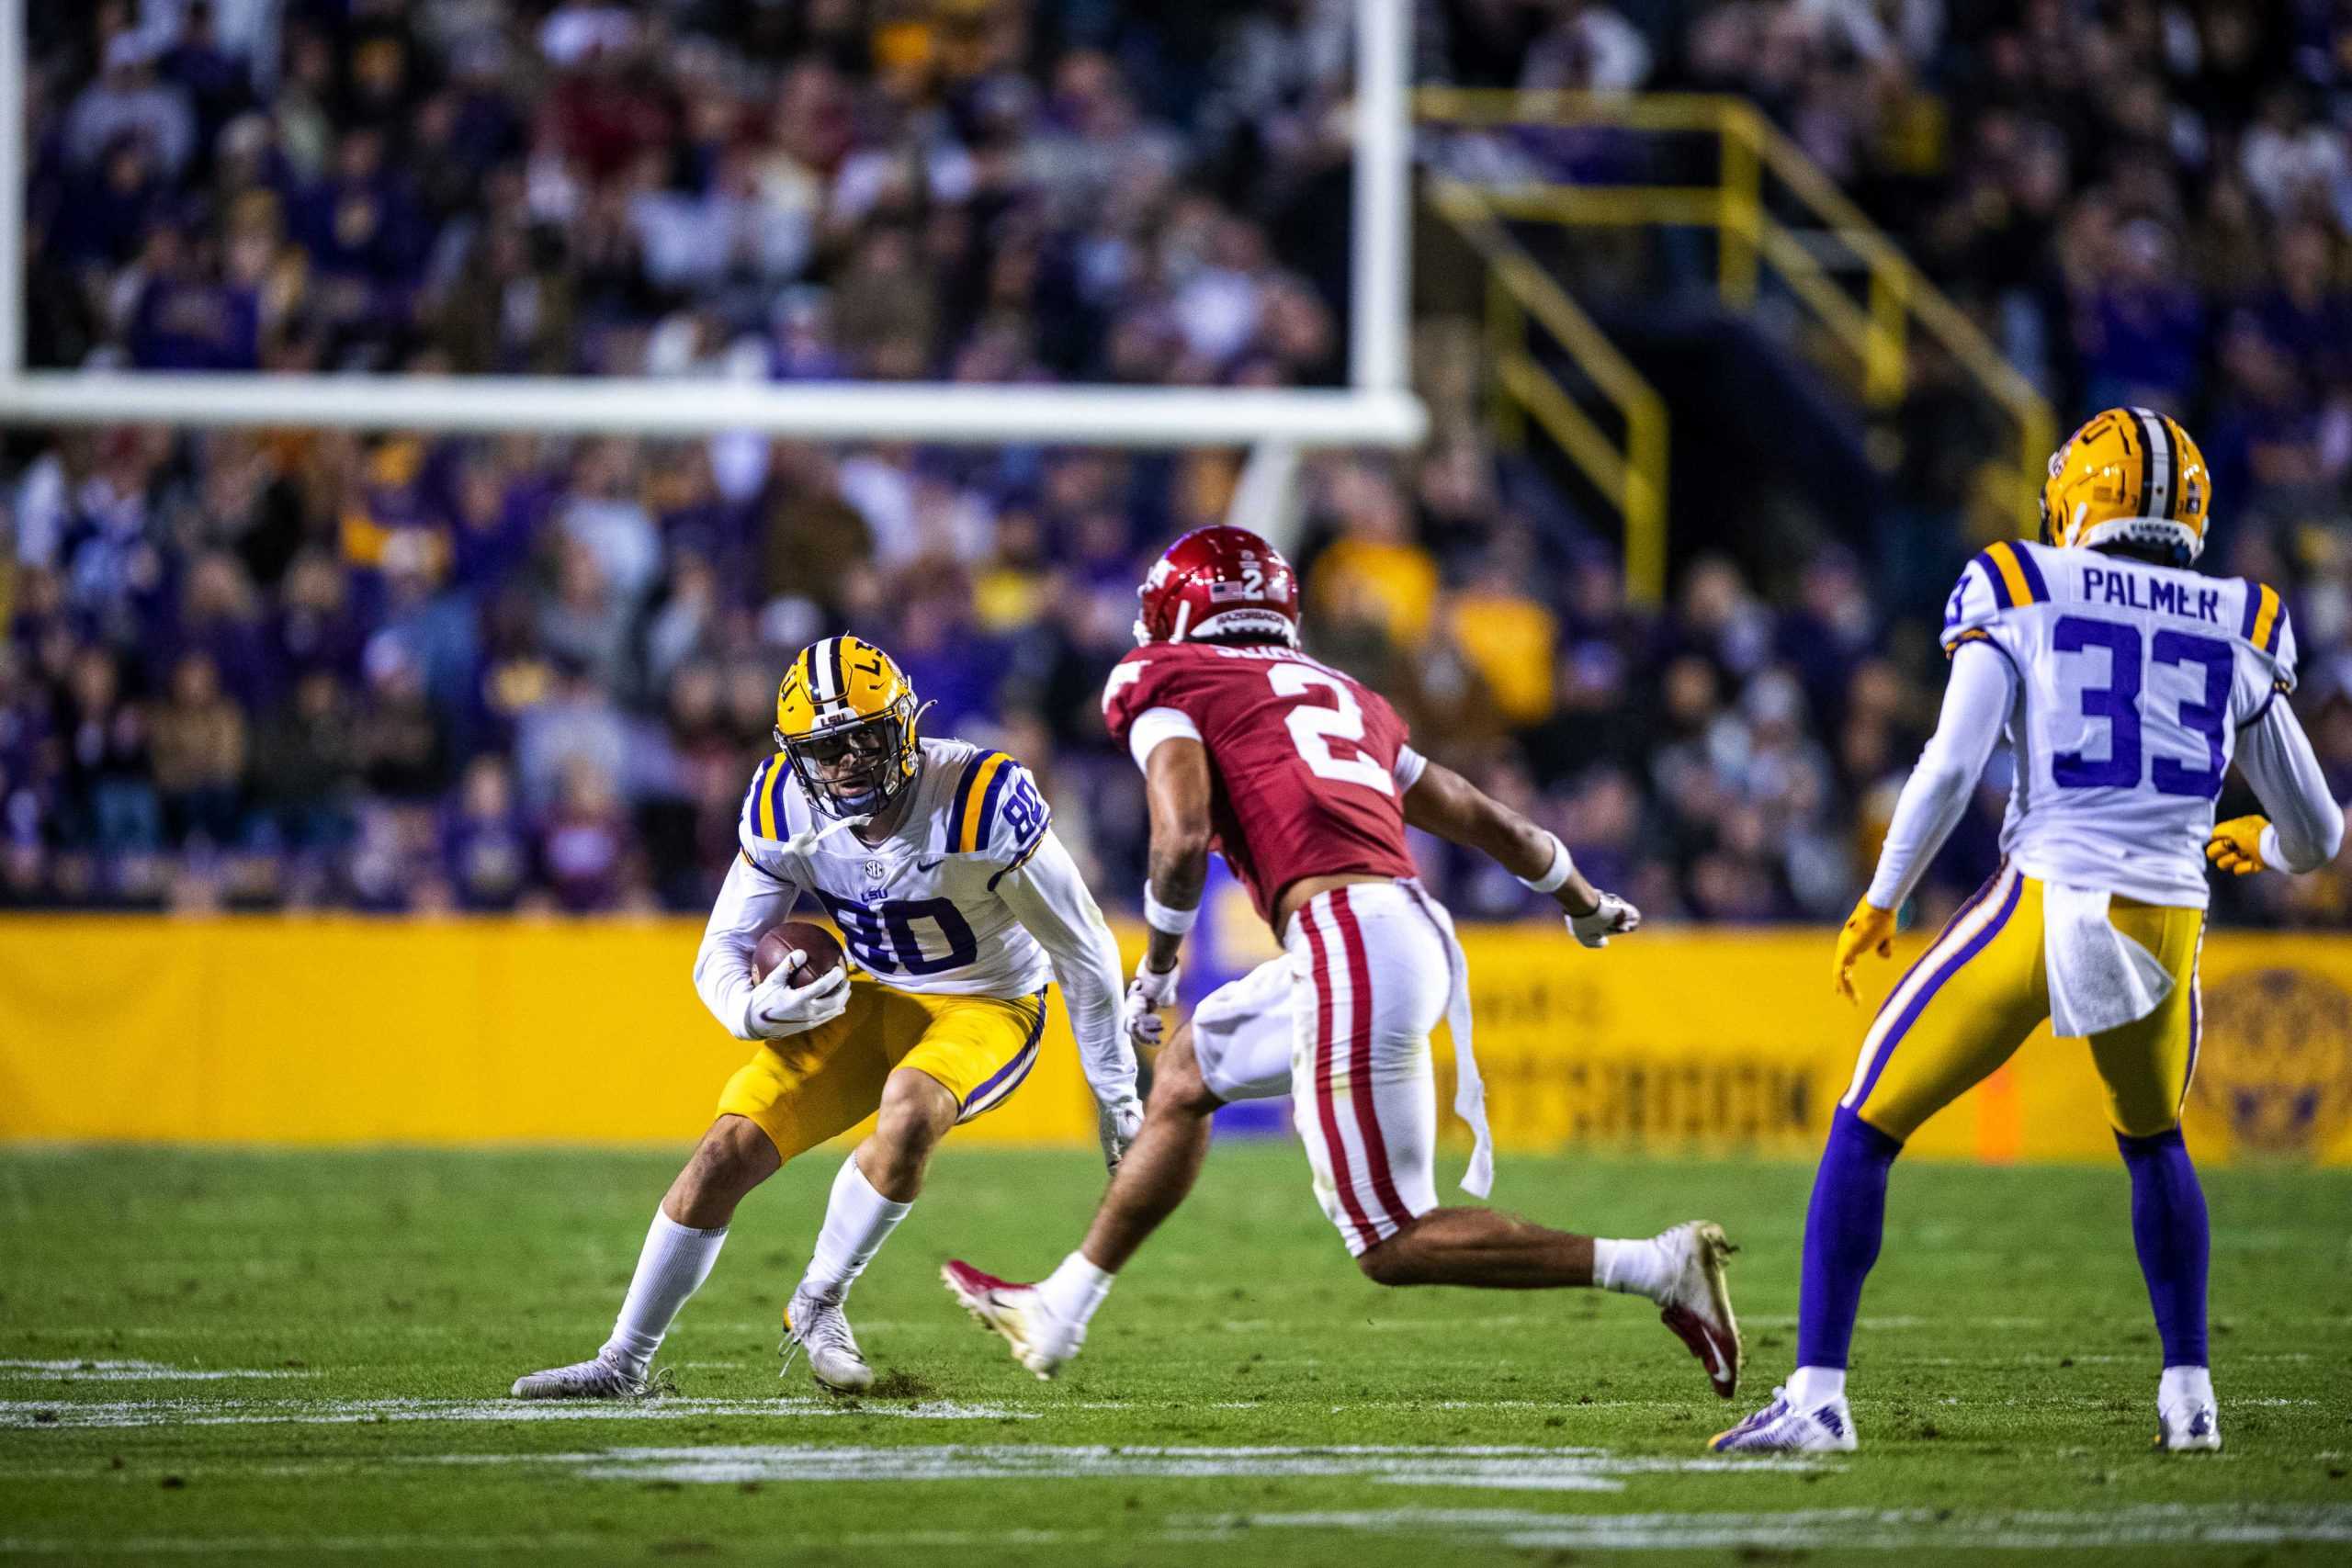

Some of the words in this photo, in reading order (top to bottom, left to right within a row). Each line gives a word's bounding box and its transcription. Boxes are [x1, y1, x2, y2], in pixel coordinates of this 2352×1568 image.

[1242, 569, 1264, 600] 2
[2083, 568, 2218, 624] PALMER
[1267, 663, 1395, 796] 2
[2052, 615, 2234, 800] 33
[1002, 773, 1042, 845] 80
[814, 886, 978, 976] 80
[861, 888, 888, 902] LSU
